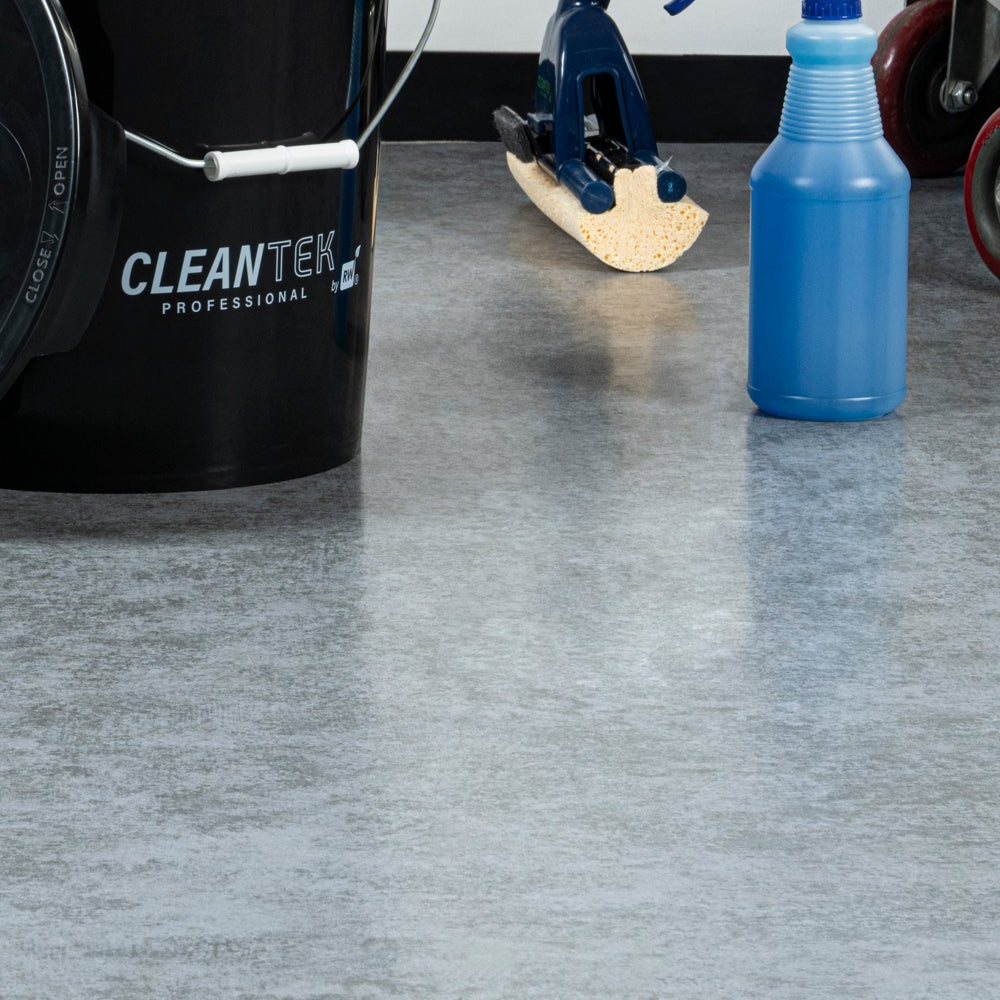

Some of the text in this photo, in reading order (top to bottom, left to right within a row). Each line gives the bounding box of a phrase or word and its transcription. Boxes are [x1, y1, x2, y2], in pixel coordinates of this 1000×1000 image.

[53, 147, 69, 196] OPEN
[25, 248, 52, 303] CLOSE
[121, 230, 335, 296] CLEANTEK
[331, 280, 339, 294] by
[162, 287, 308, 315] PROFESSIONAL
